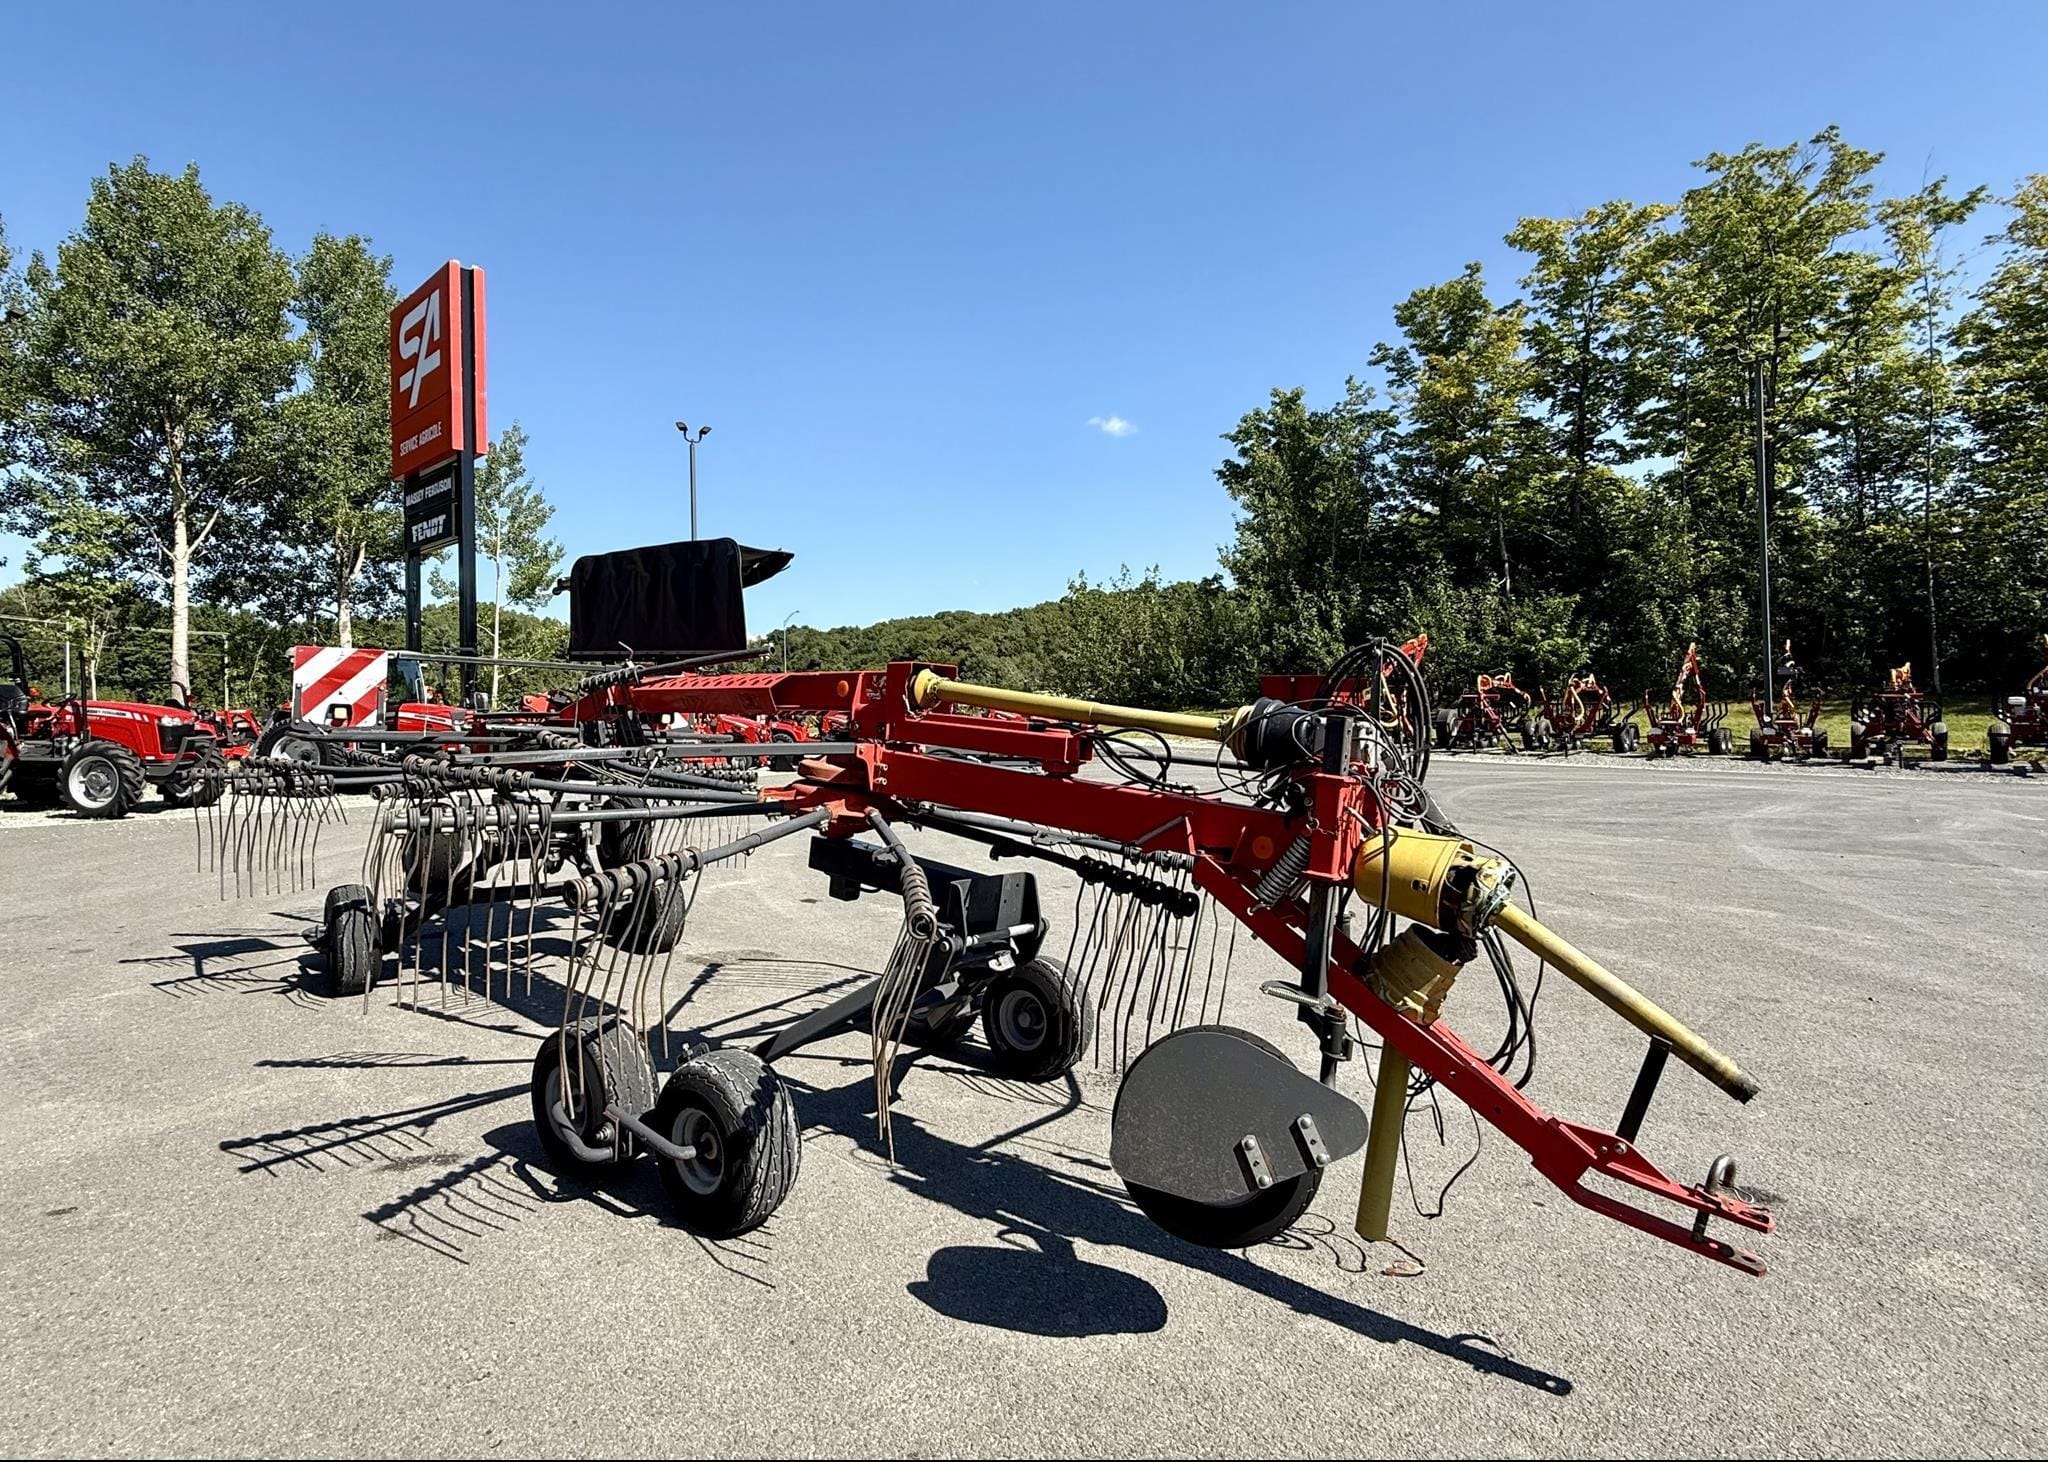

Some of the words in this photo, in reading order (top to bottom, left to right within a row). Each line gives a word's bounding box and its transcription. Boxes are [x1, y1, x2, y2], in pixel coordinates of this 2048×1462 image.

[400, 435, 418, 457] SERVICE
[419, 421, 442, 447] AGRICOLE
[406, 488, 424, 507] MASSEY
[425, 477, 452, 499] FERGUSON
[411, 514, 446, 543] FENDT
